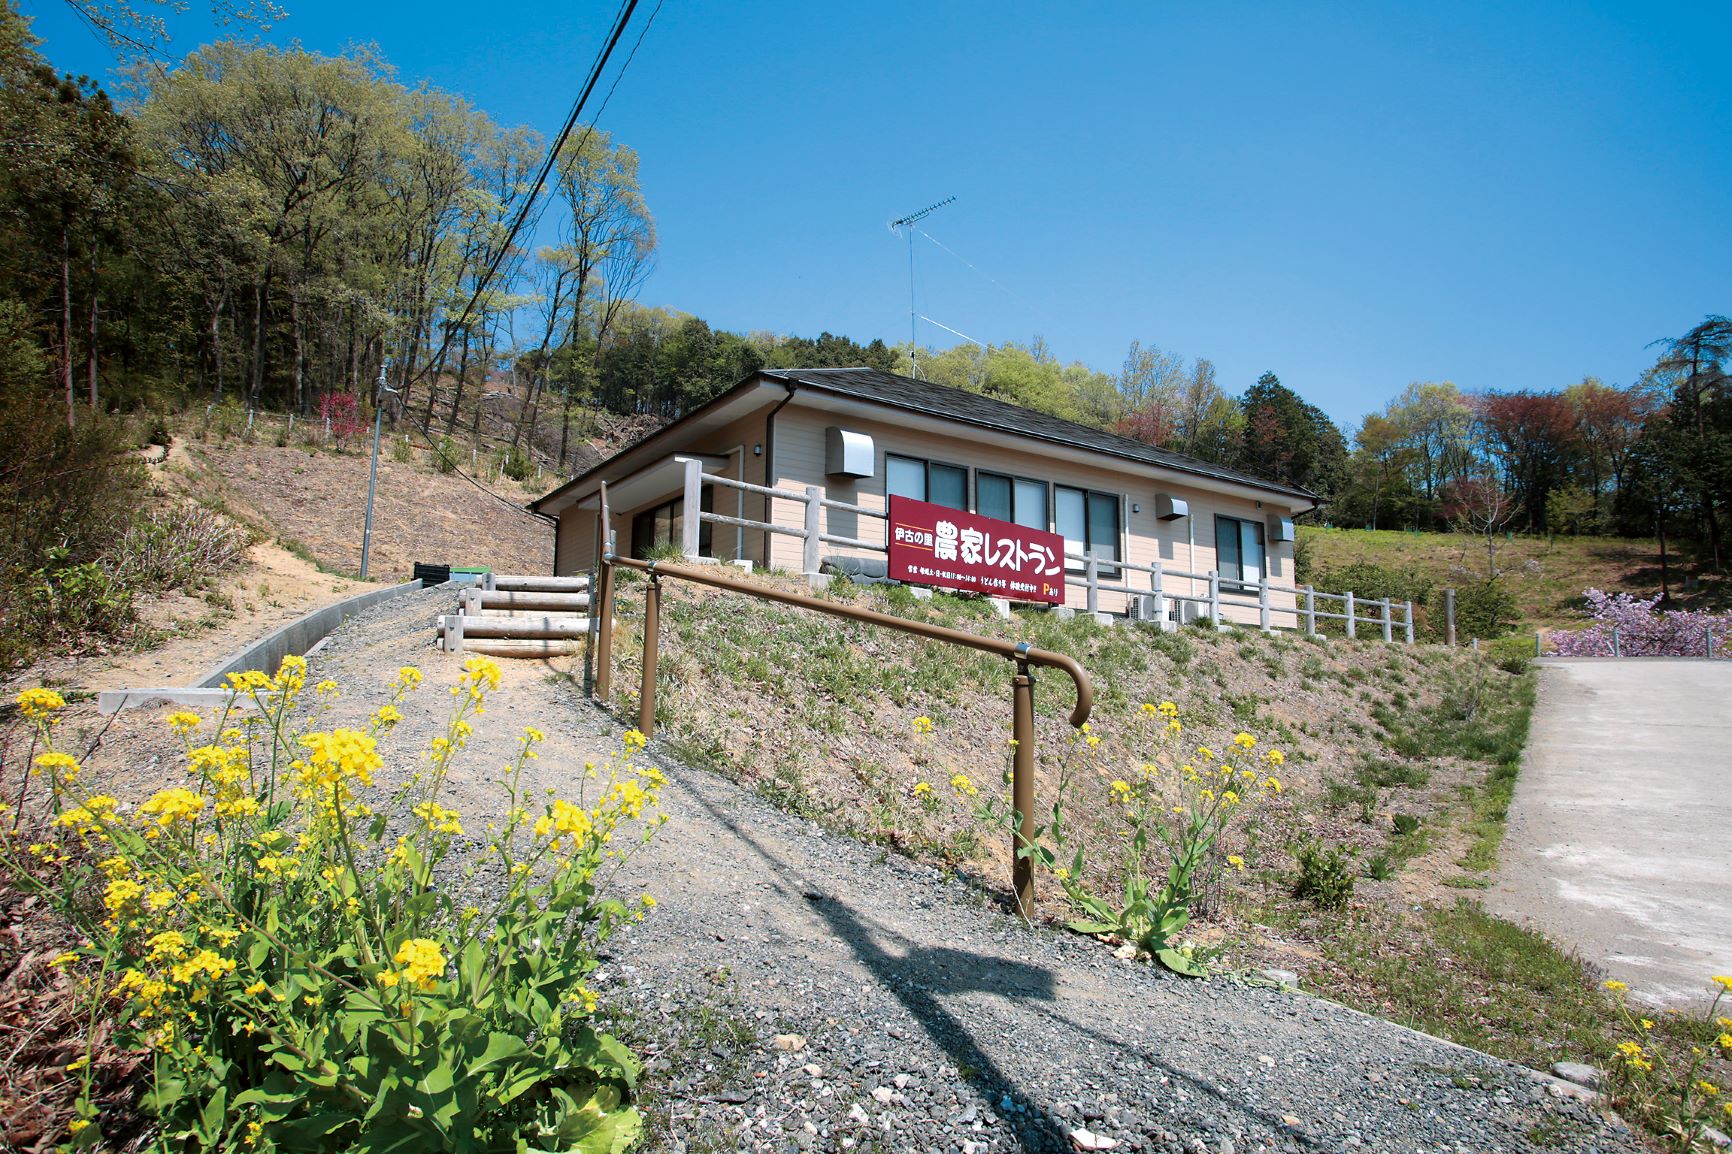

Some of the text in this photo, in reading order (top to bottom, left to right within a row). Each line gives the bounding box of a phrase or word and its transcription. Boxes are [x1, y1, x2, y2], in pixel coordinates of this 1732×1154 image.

[895, 526, 933, 546] 伊古の里
[934, 520, 1061, 576] 農家レストラン
